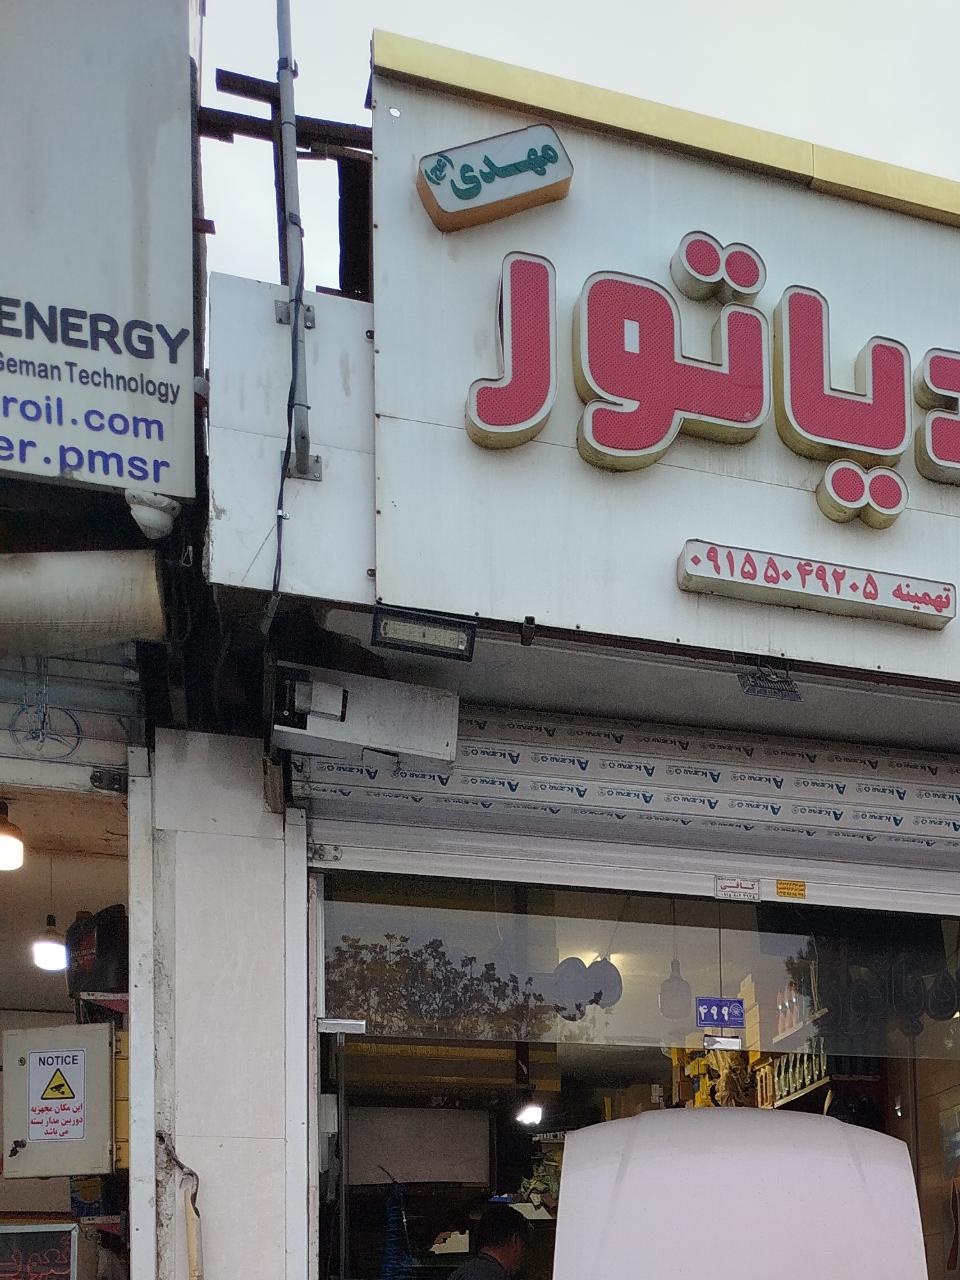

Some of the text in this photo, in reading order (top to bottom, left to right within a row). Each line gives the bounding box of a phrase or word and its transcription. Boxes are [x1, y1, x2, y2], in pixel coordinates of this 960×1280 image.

[451, 144, 559, 200] مهدی
[0, 296, 190, 364] ENERGY
[65, 361, 181, 405] Technology
[699, 1005, 729, 1021] ۴۹۹
[38, 1055, 79, 1066] NOTICE
